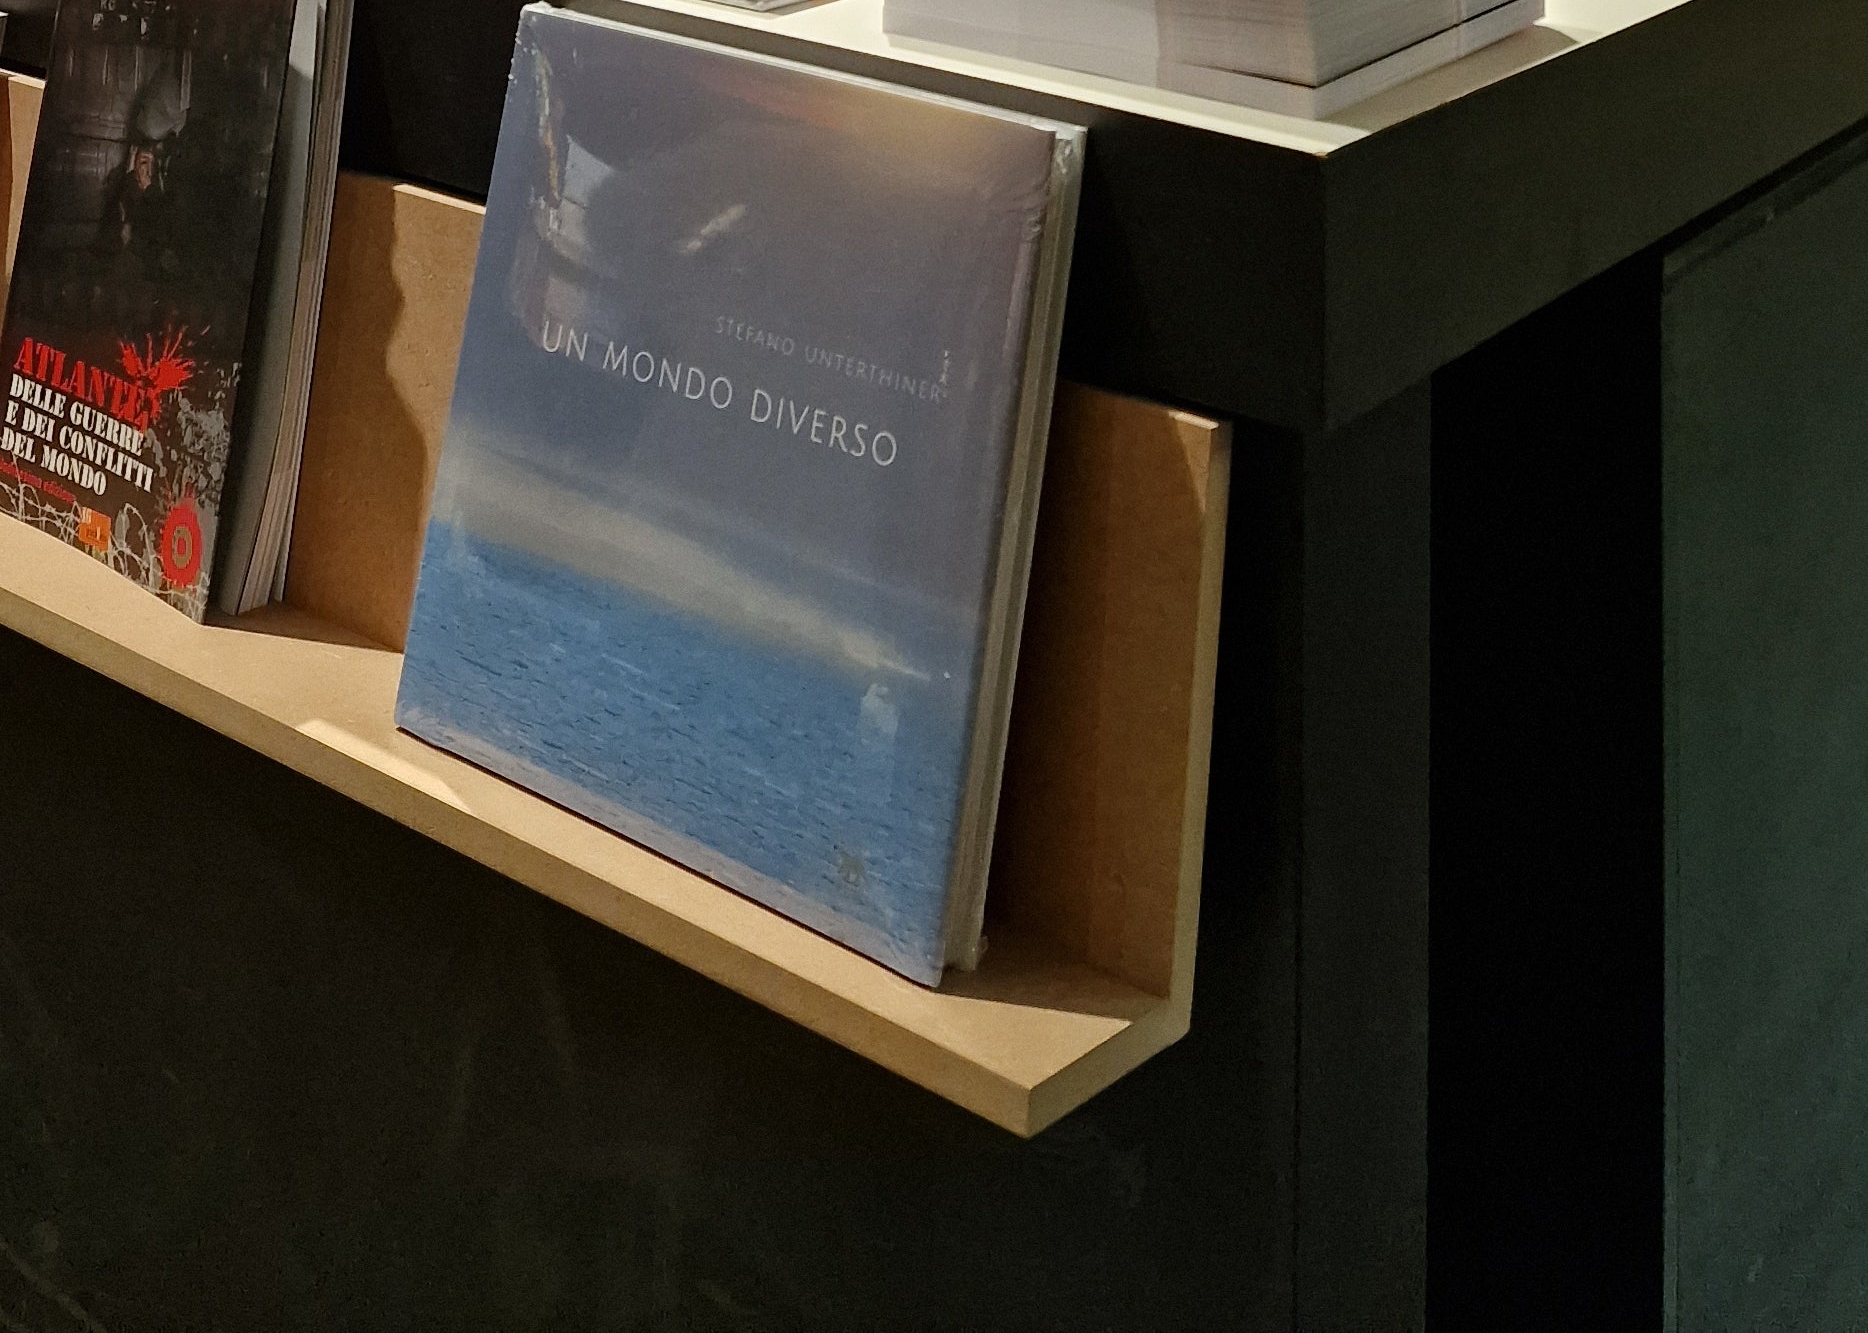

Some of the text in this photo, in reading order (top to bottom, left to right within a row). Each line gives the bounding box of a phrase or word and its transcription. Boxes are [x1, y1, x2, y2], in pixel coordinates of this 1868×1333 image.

[13, 337, 152, 433] ATLANTE
[541, 319, 900, 469] UN MONDO DIVERSO
[714, 314, 944, 406] STEFANO UNTERTHINER
[0, 426, 36, 464] DEL
[41, 443, 107, 496] MONDO
[5, 399, 18, 425] E
[21, 409, 56, 443] DEI
[59, 427, 155, 494] CONFLITTI
[9, 373, 145, 457] DELLE GUERRE
